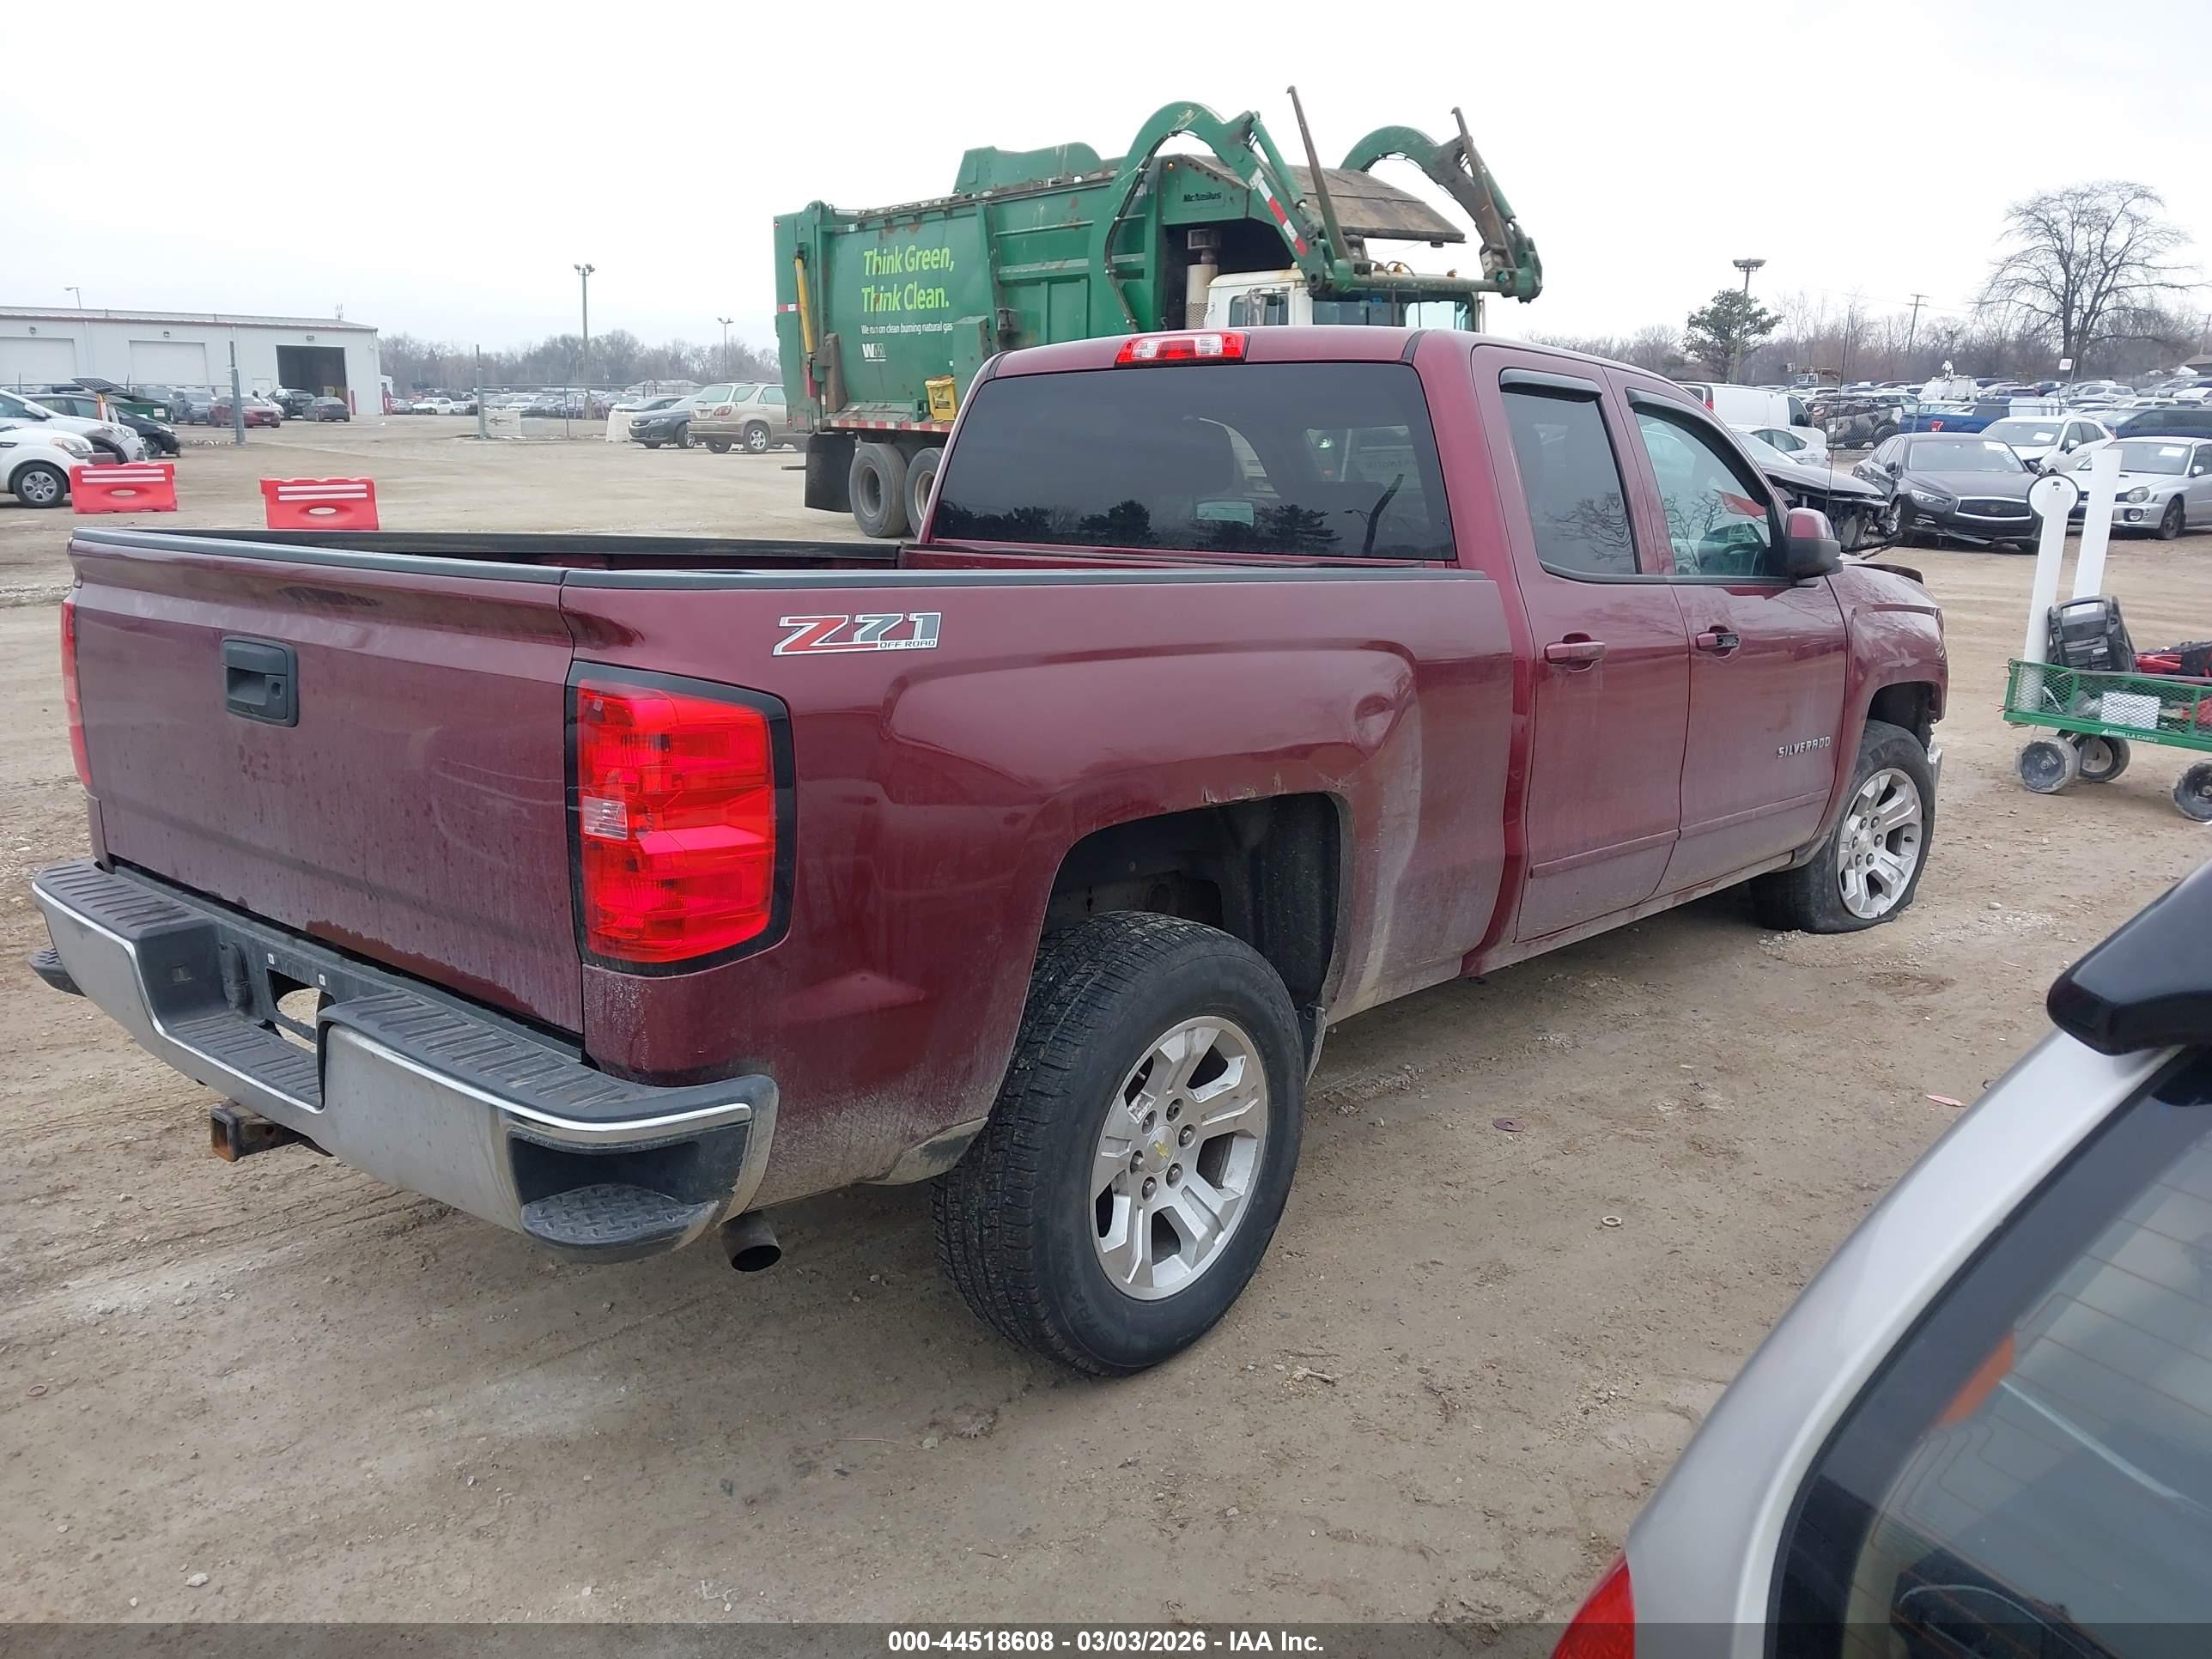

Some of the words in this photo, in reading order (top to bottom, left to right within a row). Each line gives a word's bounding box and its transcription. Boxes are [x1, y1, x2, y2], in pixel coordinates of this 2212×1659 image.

[864, 245, 902, 276] Think
[904, 244, 955, 272] Green,
[861, 283, 902, 313] Think
[903, 282, 950, 310] Clean.
[860, 325, 870, 334] We
[870, 325, 878, 334] run
[878, 325, 886, 334] on
[885, 323, 900, 333] clean
[900, 322, 921, 335] burning
[921, 320, 943, 332] natural
[943, 322, 954, 333] gas
[772, 611, 943, 657] Z71
[879, 641, 902, 649] OFF
[902, 639, 936, 648] ROAD
[1778, 736, 1831, 758] SILVERADO
